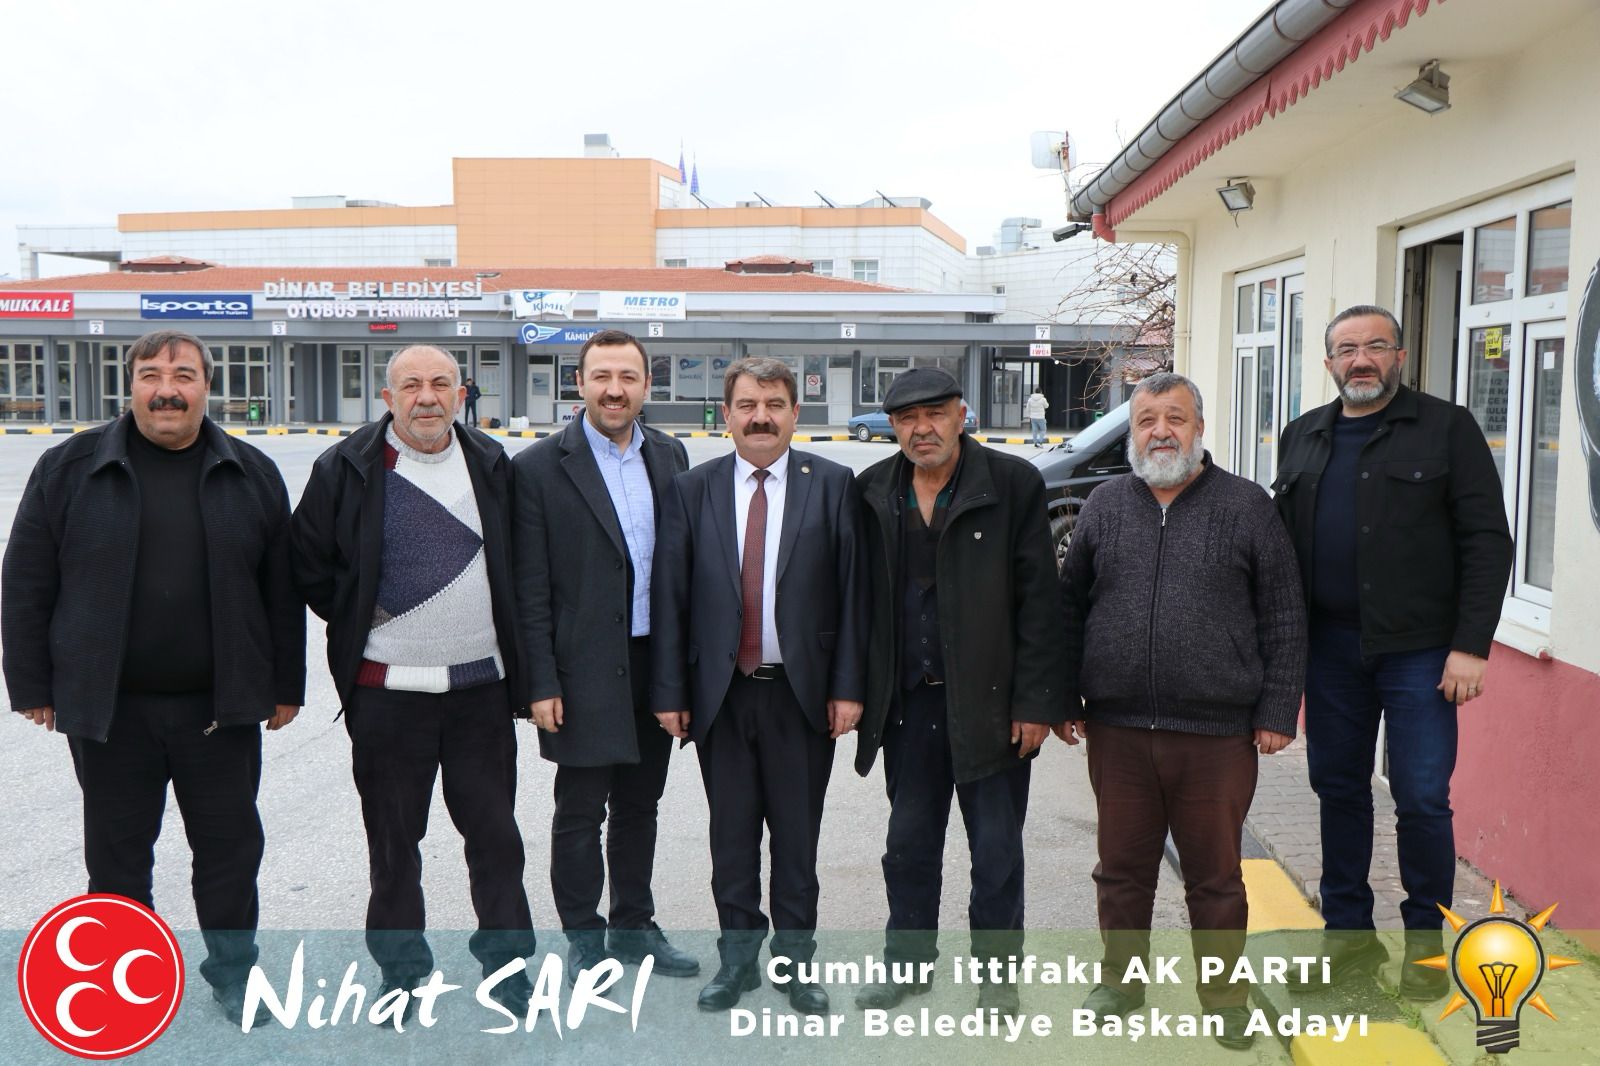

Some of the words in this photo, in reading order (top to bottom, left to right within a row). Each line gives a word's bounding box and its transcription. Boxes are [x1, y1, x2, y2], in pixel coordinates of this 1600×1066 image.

[264, 277, 335, 298] DİNAR
[348, 277, 482, 298] BELEDİYESİ
[142, 299, 248, 313] Isparta
[623, 296, 679, 307] METRO
[367, 299, 461, 318] TERMİNALİ
[93, 324, 100, 334] 2
[276, 325, 283, 334] 3
[461, 326, 467, 334] 4
[653, 327, 659, 336] 5
[845, 328, 852, 337] 6
[1040, 329, 1046, 338] 7
